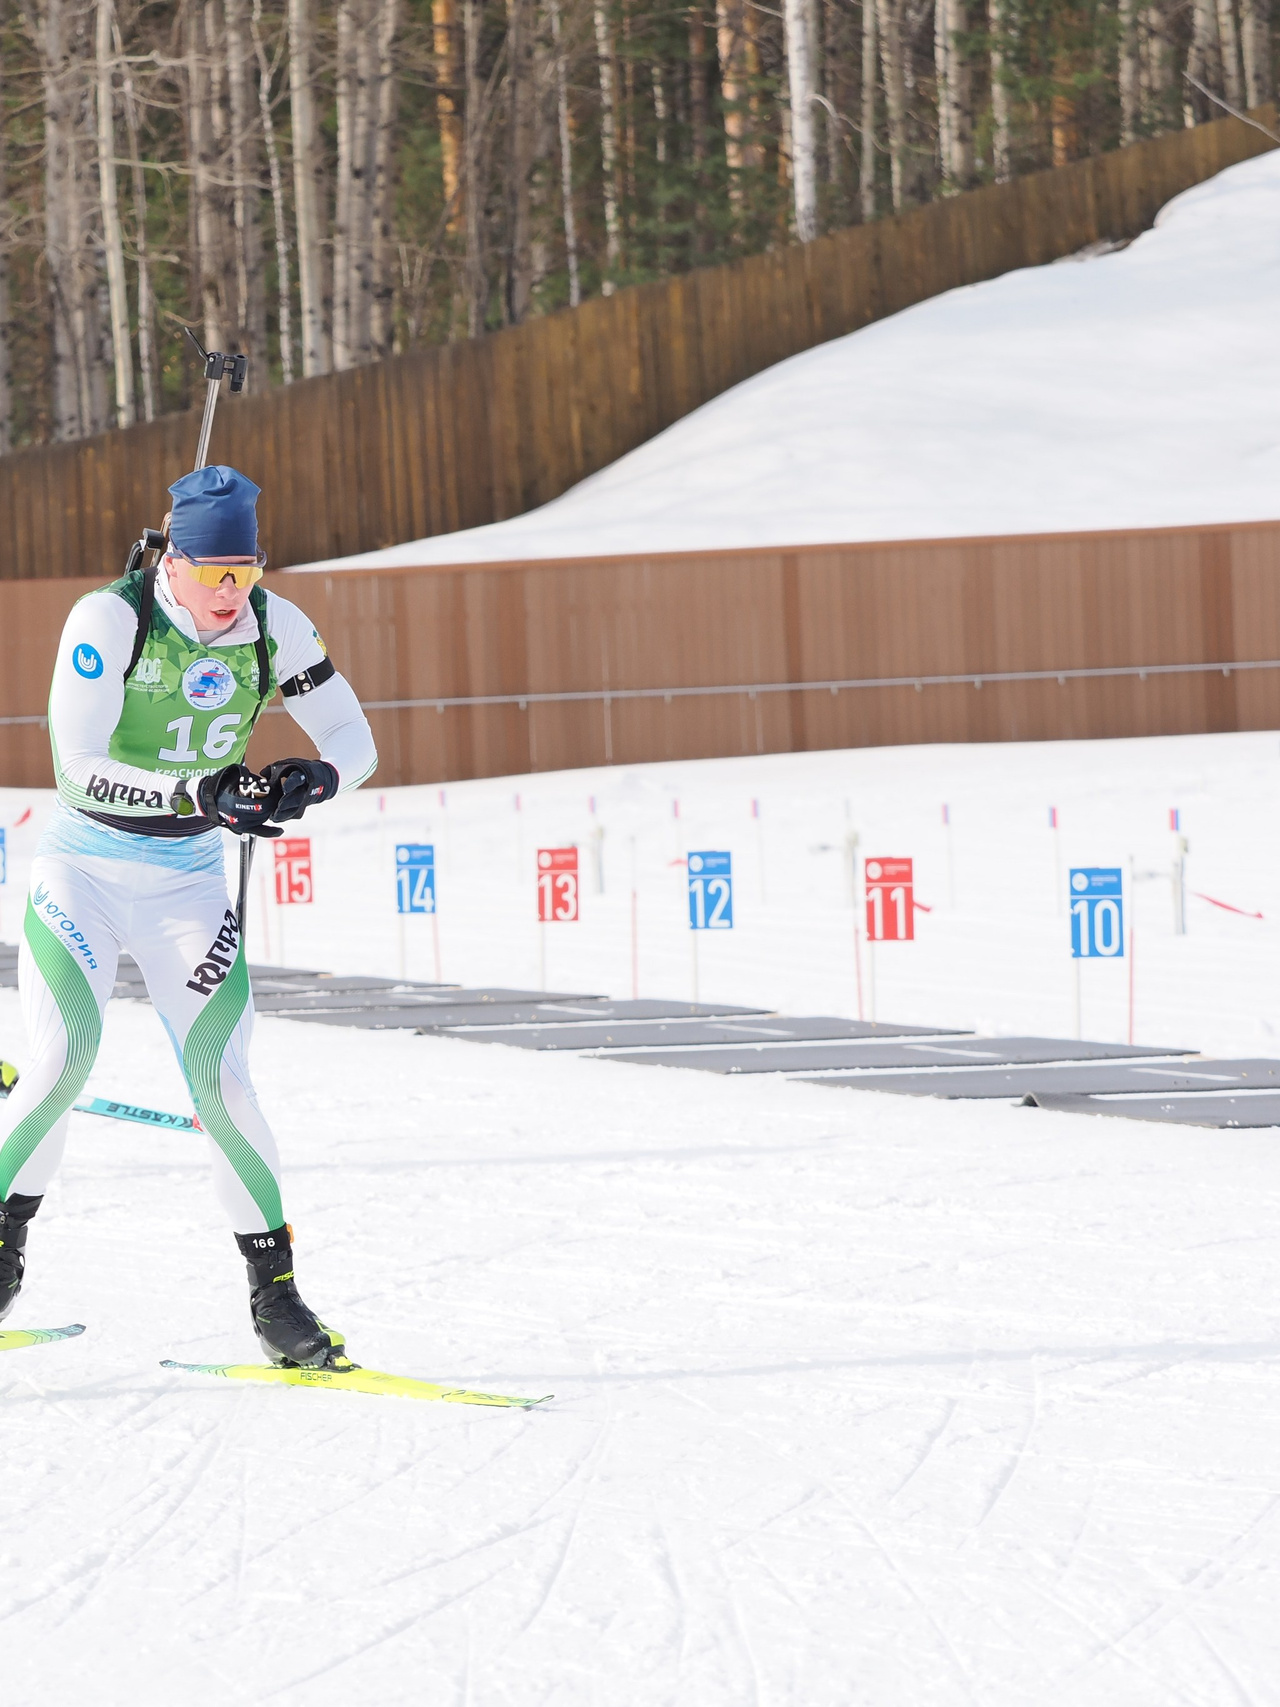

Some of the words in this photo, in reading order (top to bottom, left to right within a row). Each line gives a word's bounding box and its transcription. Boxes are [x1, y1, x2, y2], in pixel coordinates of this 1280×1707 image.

[157, 712, 242, 763] 16
[154, 767, 222, 779] КРАСНОЯР
[275, 860, 311, 903] 15
[397, 869, 434, 912] 14
[538, 873, 577, 921] 13
[688, 878, 730, 929] 12
[44, 900, 98, 970] ЮГОРИЯ
[866, 886, 906, 940] 11
[1073, 899, 1121, 956] 10
[252, 1237, 276, 1249] 166
[273, 1270, 294, 1283] FISC
[300, 1371, 333, 1383] FISCHER
